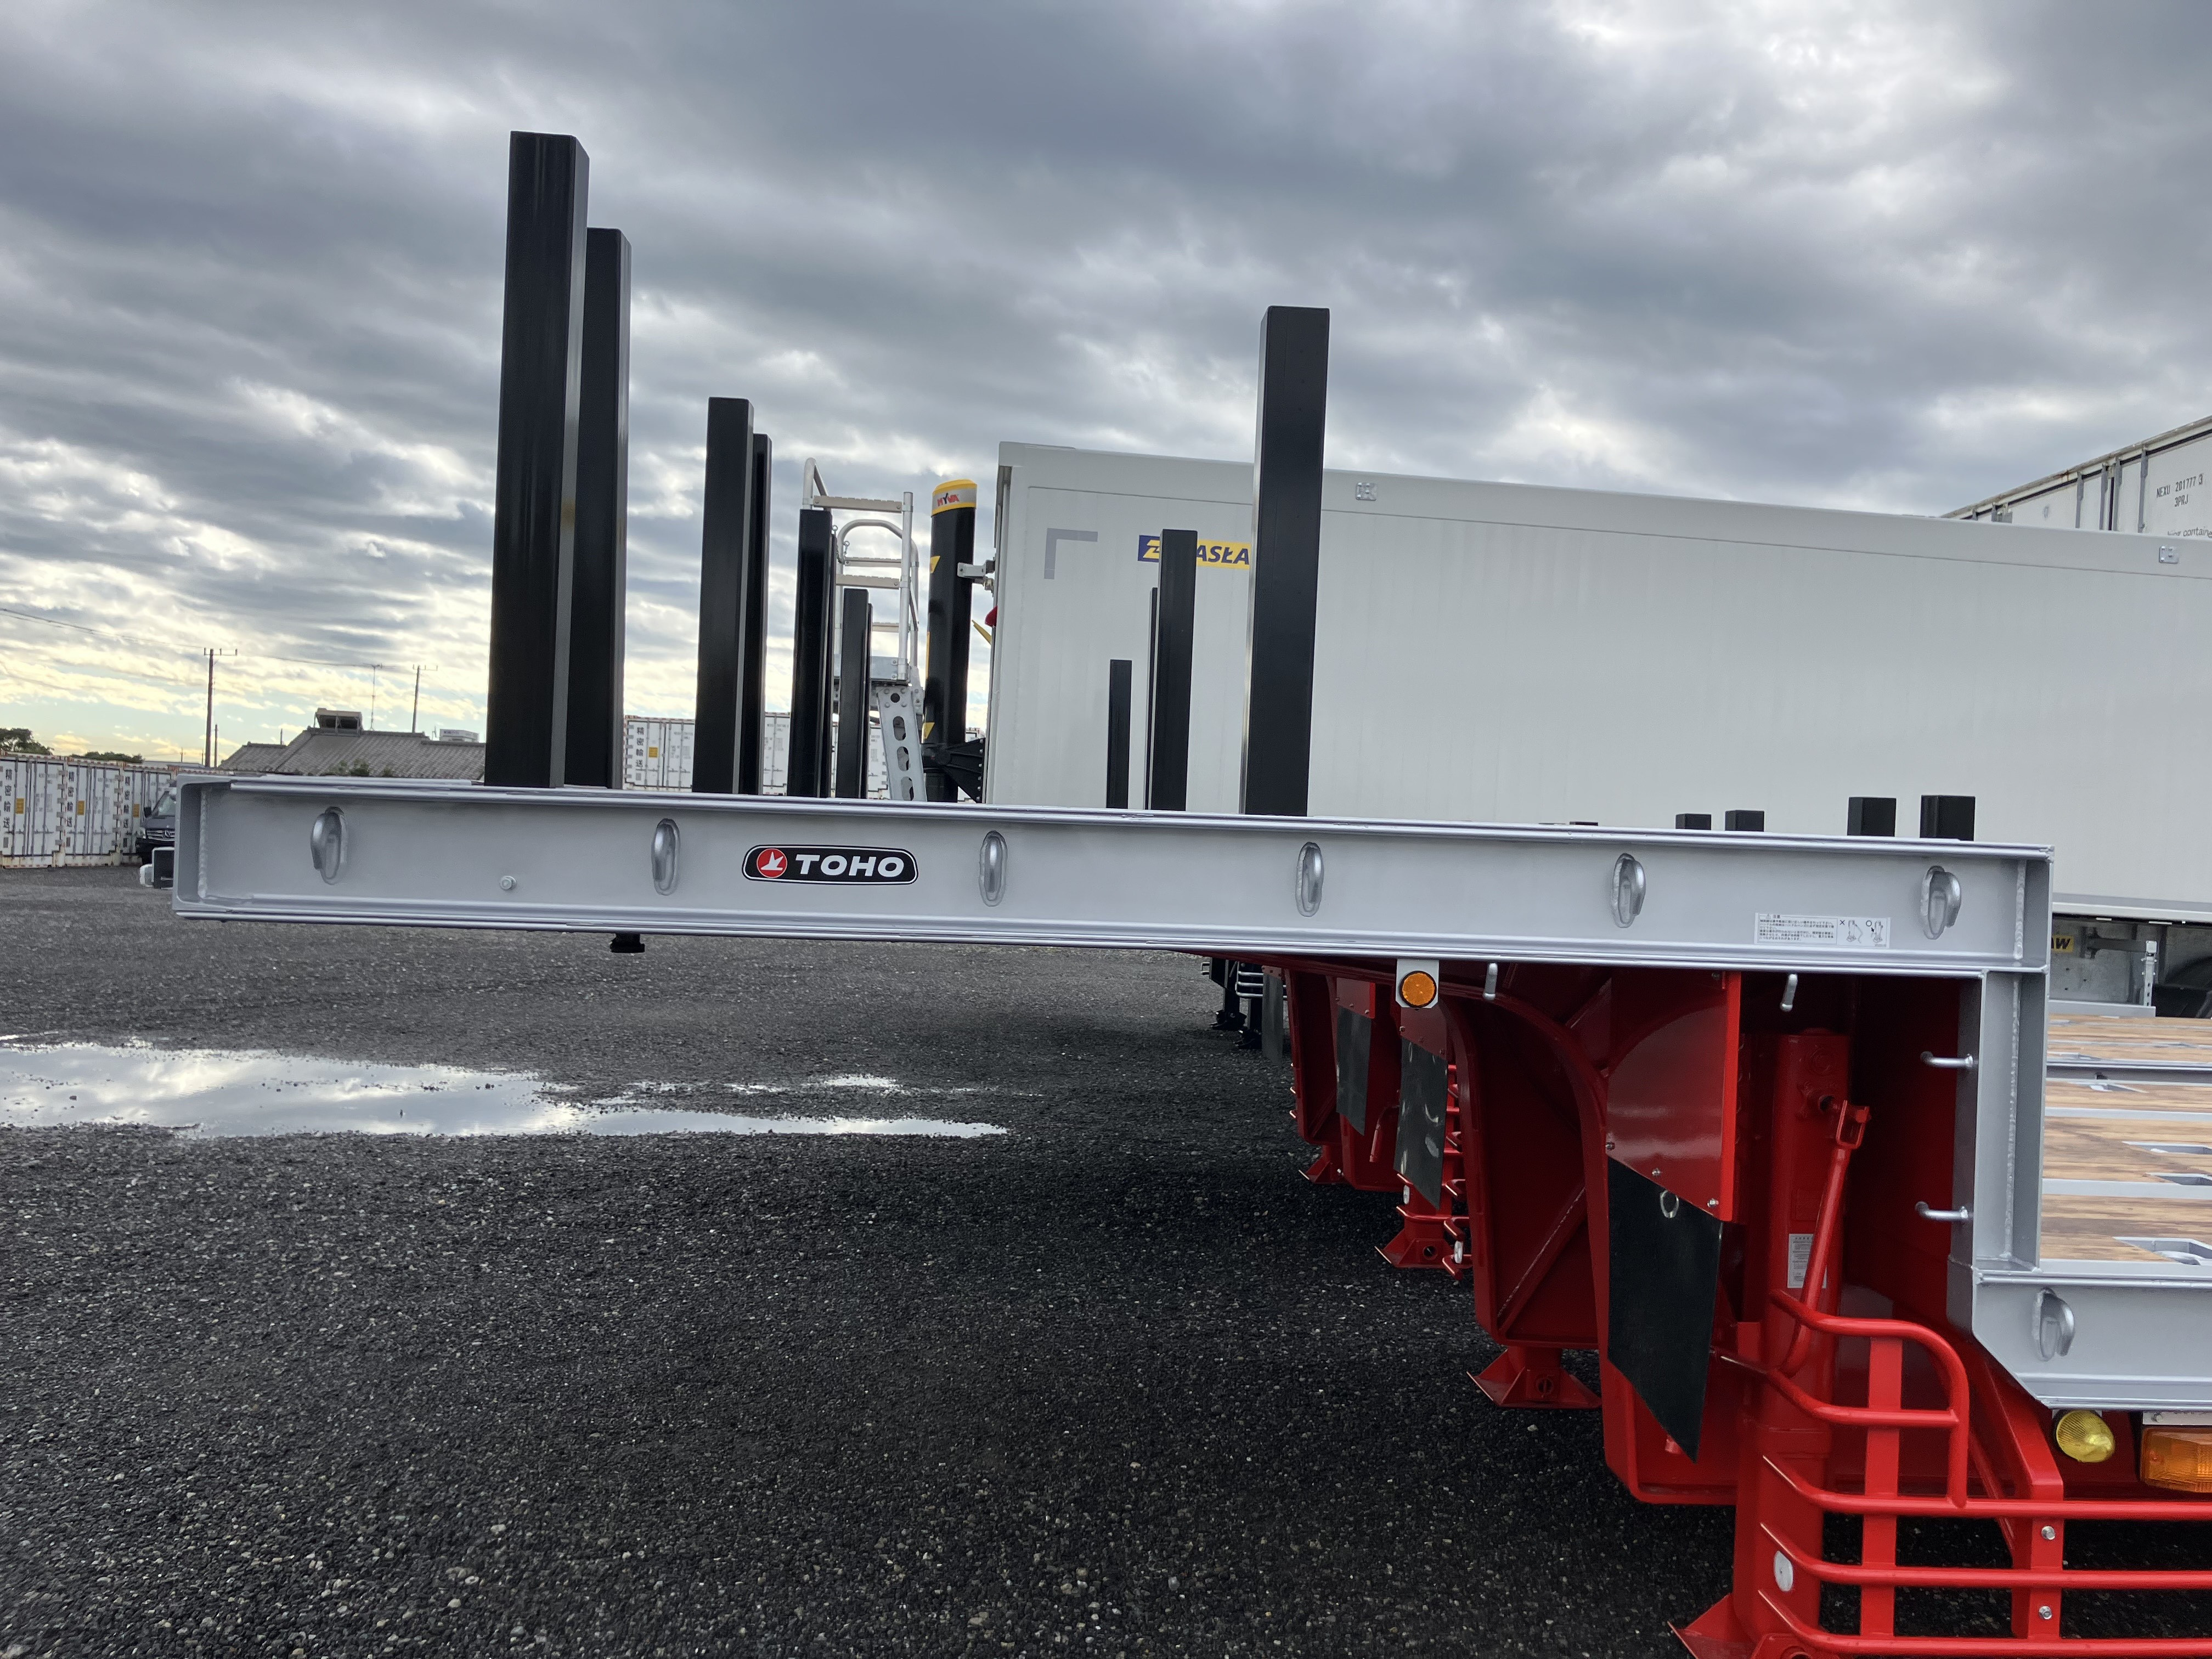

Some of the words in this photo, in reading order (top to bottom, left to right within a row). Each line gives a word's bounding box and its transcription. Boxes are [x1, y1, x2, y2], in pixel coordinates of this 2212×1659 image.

[2157, 484, 2171, 498] NEXU
[2175, 476, 2197, 492] 201777
[2198, 473, 2203, 486] 3
[937, 493, 960, 507] HYVA
[2183, 526, 2212, 538] containe
[1197, 545, 1250, 565] ASŁA
[3, 769, 13, 828] 精密輸送
[795, 854, 905, 878] TOHO
